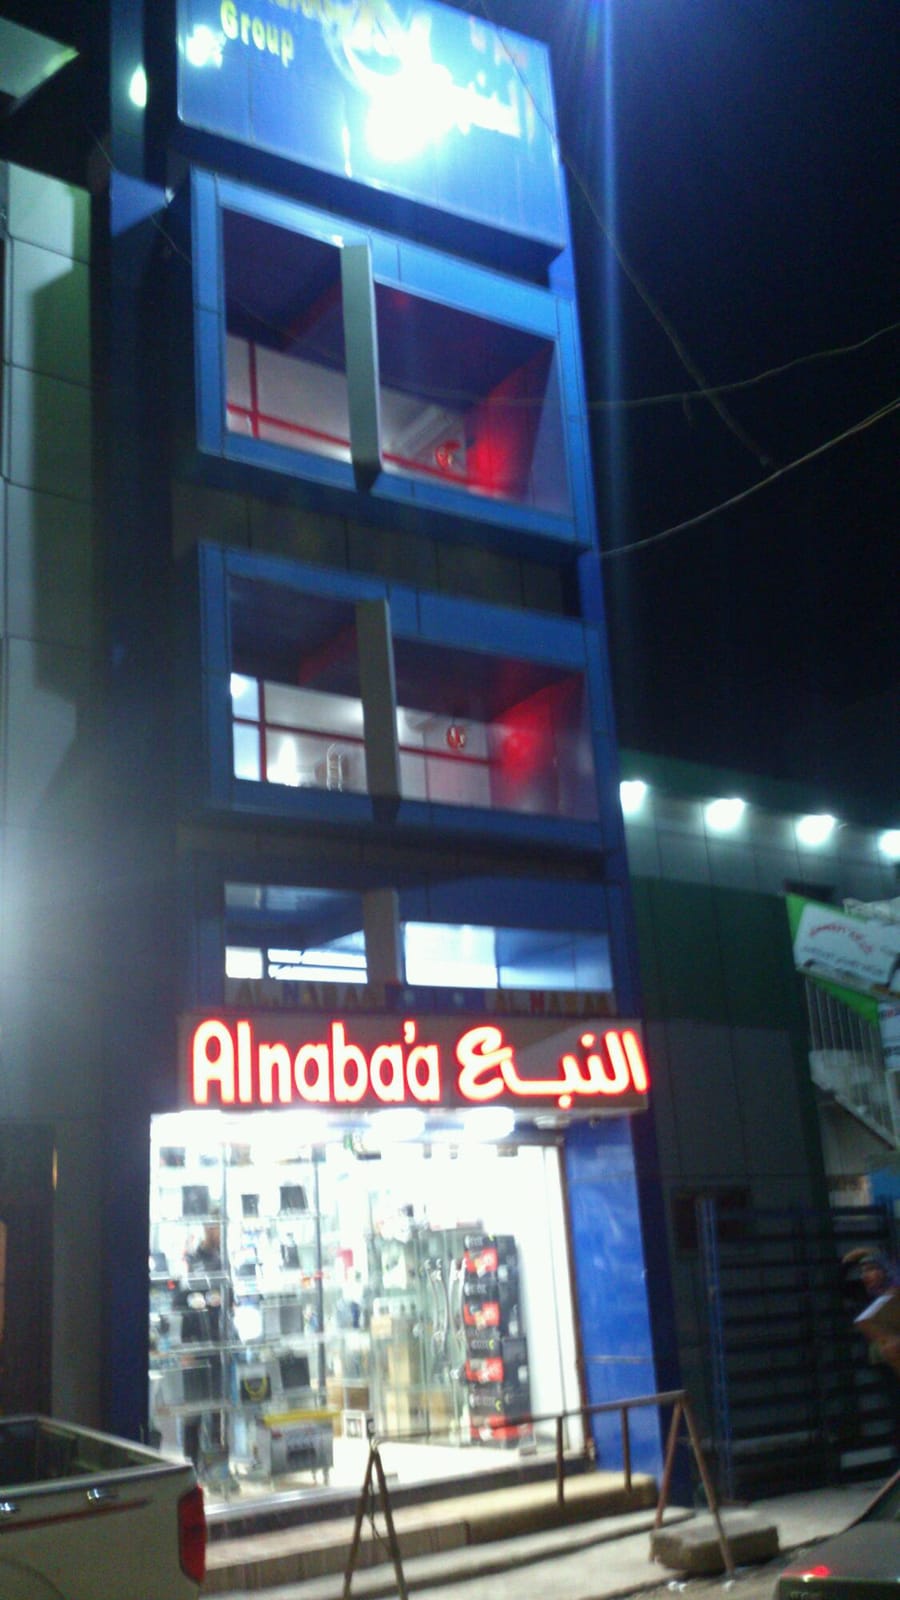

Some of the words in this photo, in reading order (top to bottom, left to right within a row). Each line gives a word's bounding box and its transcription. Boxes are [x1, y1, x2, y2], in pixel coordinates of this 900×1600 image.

[220, 0, 294, 68] Group
[192, 1018, 441, 1105] Alnaba'a
[456, 1025, 649, 1109] النبع
